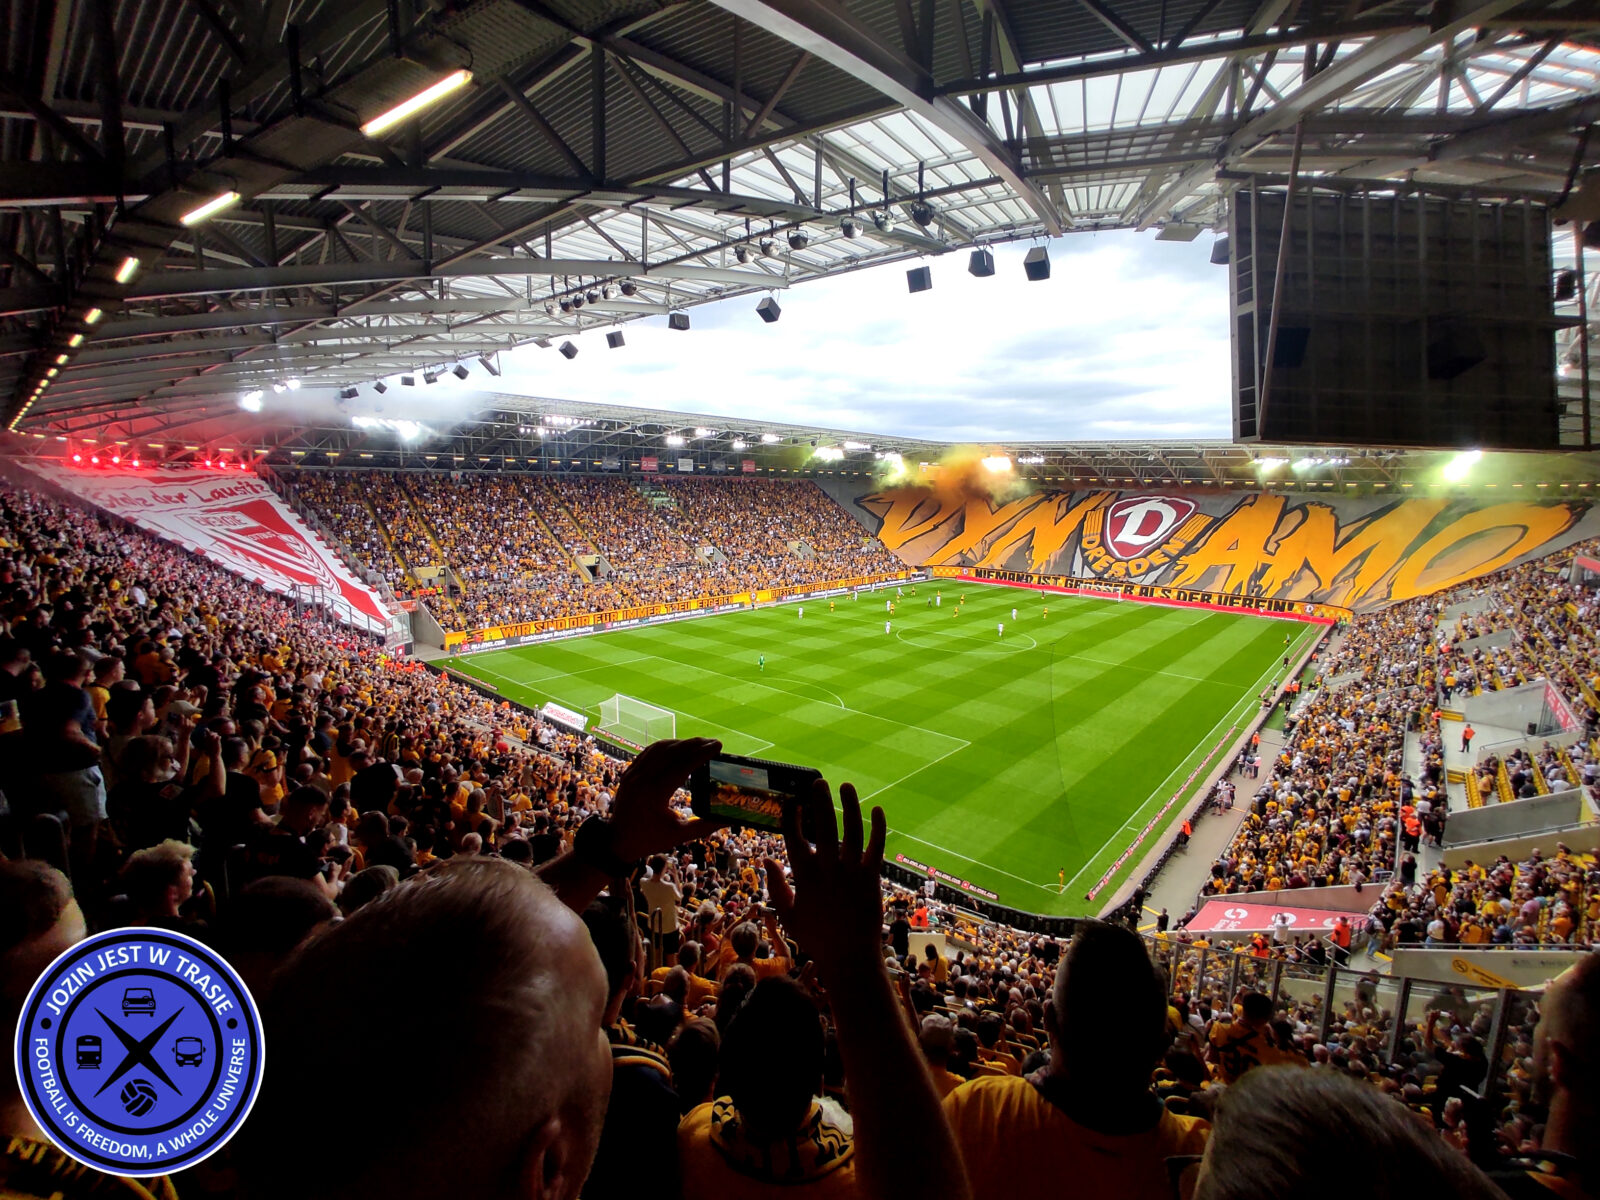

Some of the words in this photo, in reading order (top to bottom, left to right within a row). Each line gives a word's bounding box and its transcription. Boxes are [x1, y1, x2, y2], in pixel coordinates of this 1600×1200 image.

[151, 490, 189, 505] der
[189, 481, 270, 501] Lausitz
[1081, 535, 1188, 578] DRESDEN
[975, 568, 1034, 585] NIEMAND
[1037, 574, 1061, 586] IST
[1138, 587, 1172, 600] ALS
[1176, 590, 1212, 604] DER
[1217, 594, 1295, 613] VEREIN!
[501, 623, 531, 638] WIR
[535, 619, 566, 633] SIND
[568, 615, 590, 629] DIR
[593, 611, 619, 625] FÜR
[622, 605, 661, 620] IMMER
[665, 601, 689, 614] TREU
